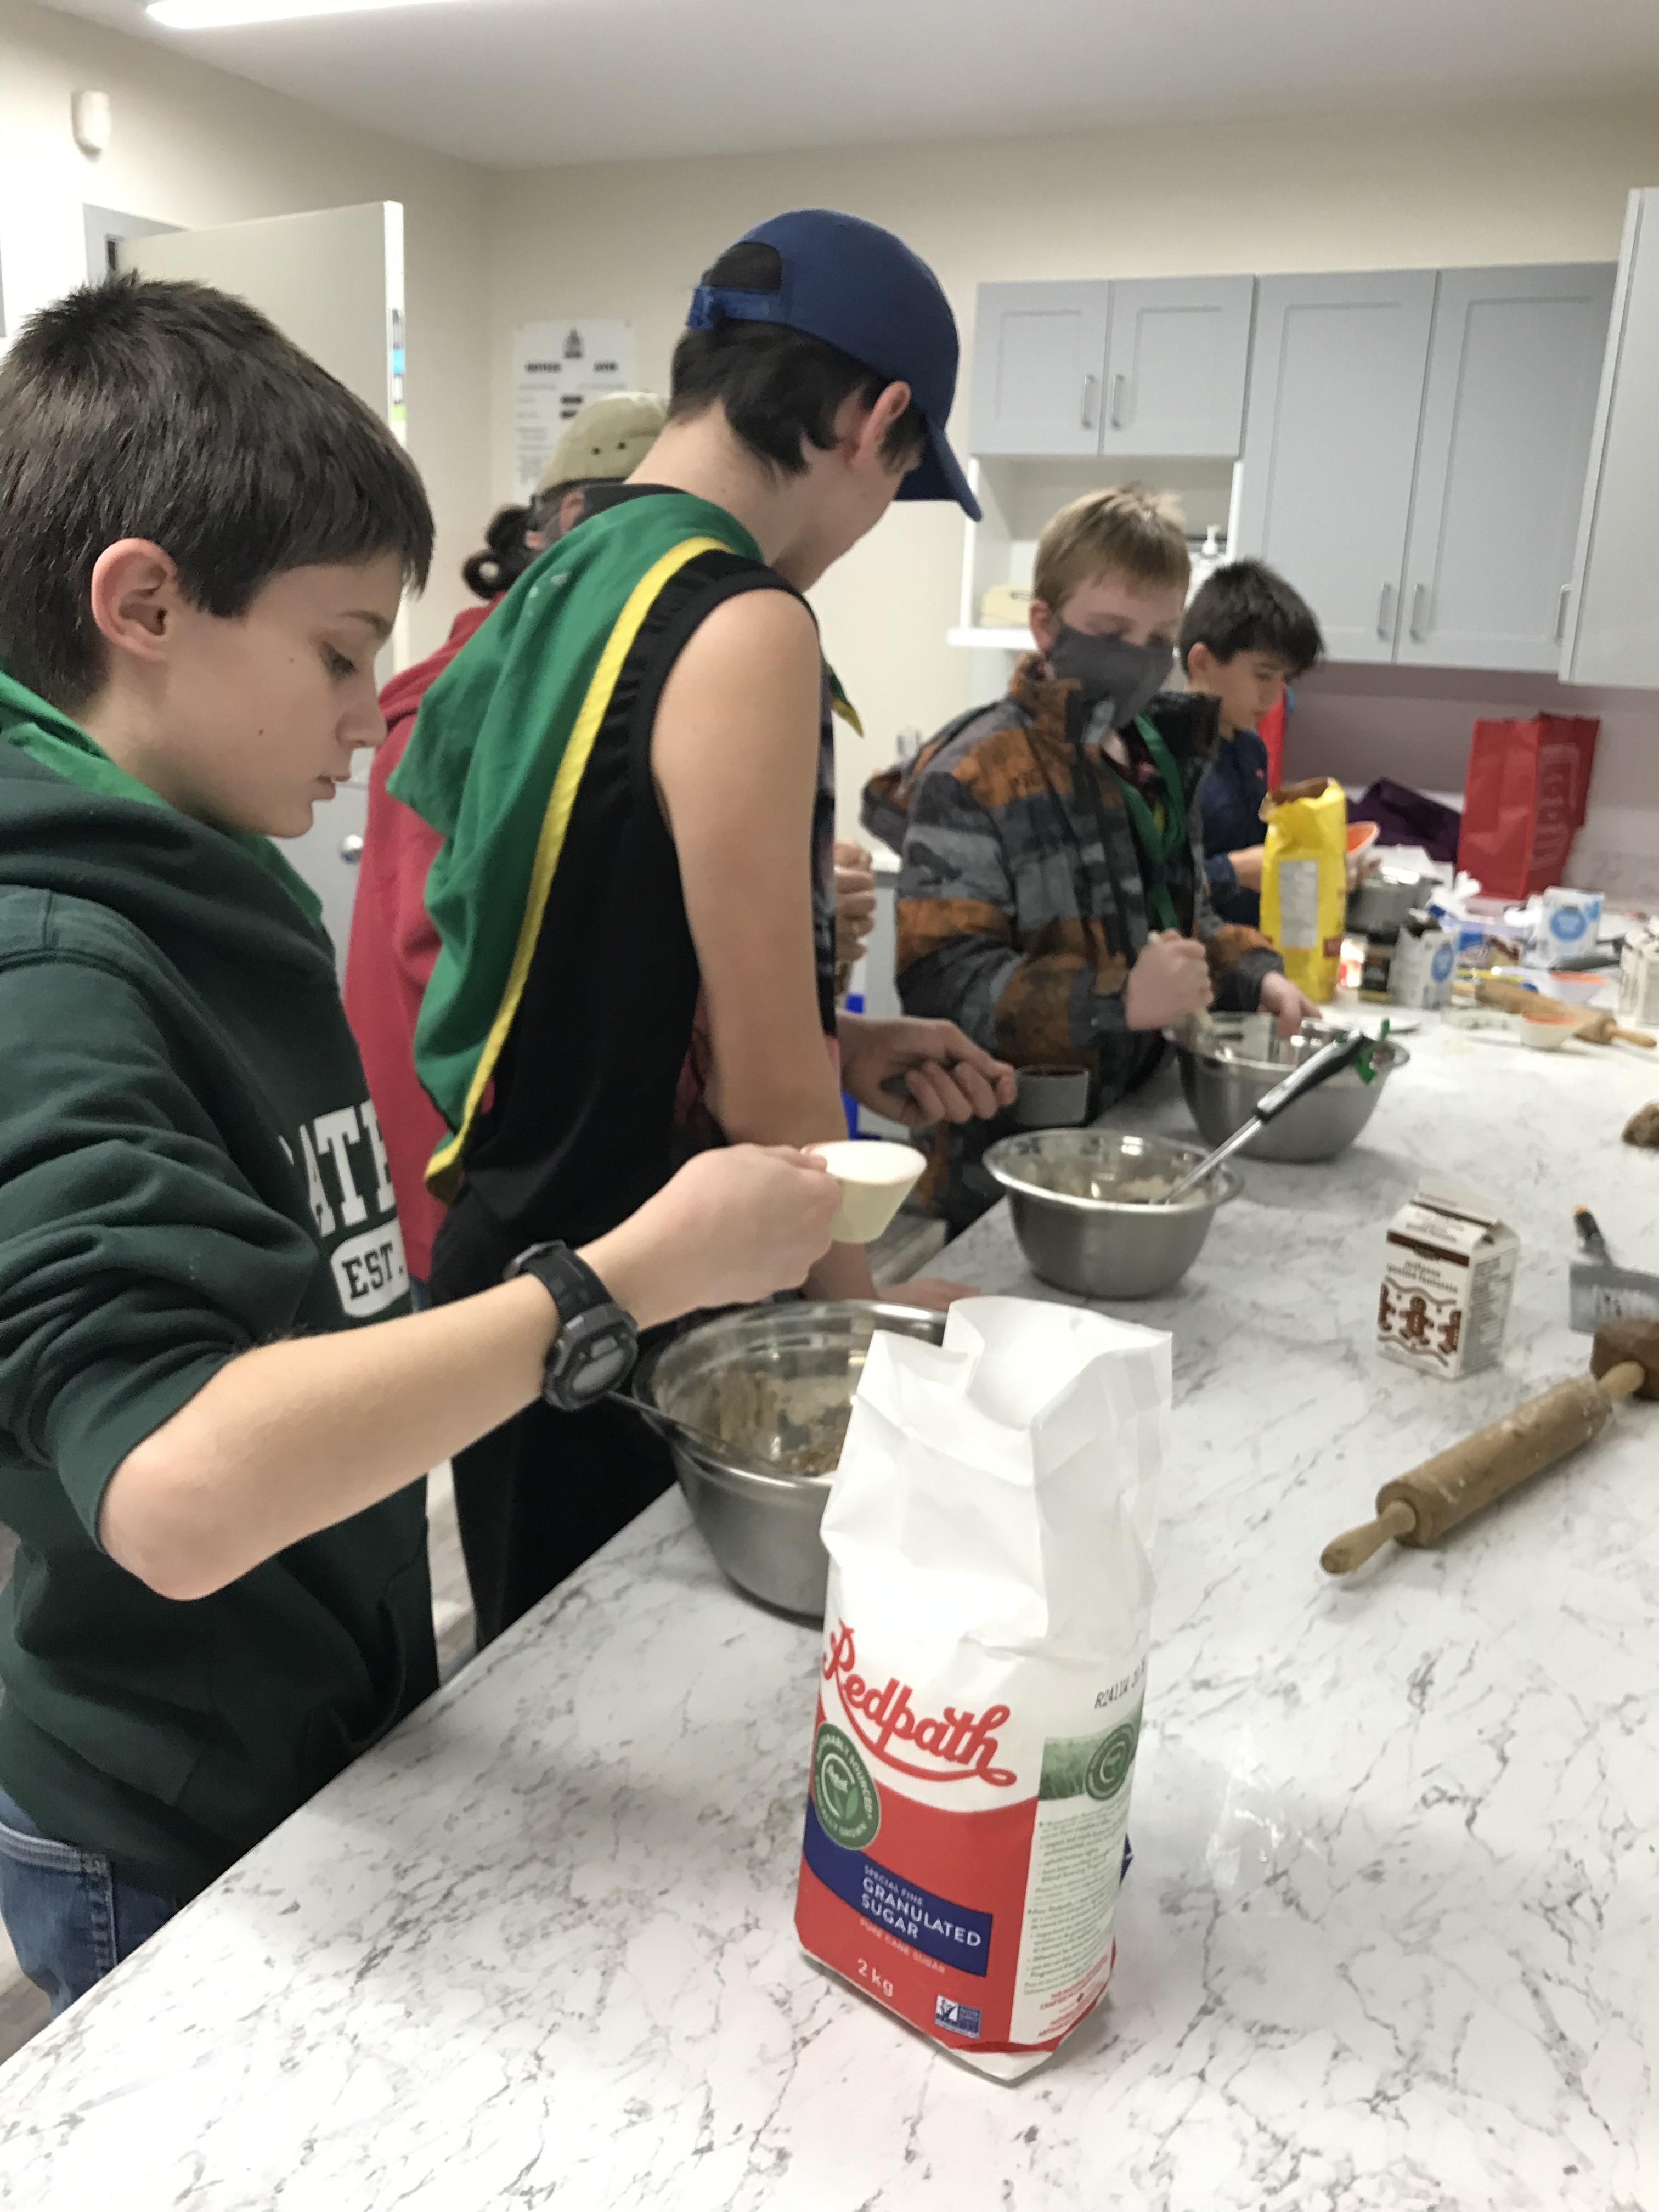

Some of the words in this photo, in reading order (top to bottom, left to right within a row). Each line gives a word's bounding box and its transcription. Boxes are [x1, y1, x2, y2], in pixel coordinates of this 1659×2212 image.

[341, 1242, 404, 1301] EST.
[822, 1617, 1018, 1787] Redpath
[861, 1893, 919, 1939] SUGAR
[863, 1877, 981, 1946] GRANULATED
[857, 1957, 867, 1977] 2
[871, 1967, 894, 1997] kg
